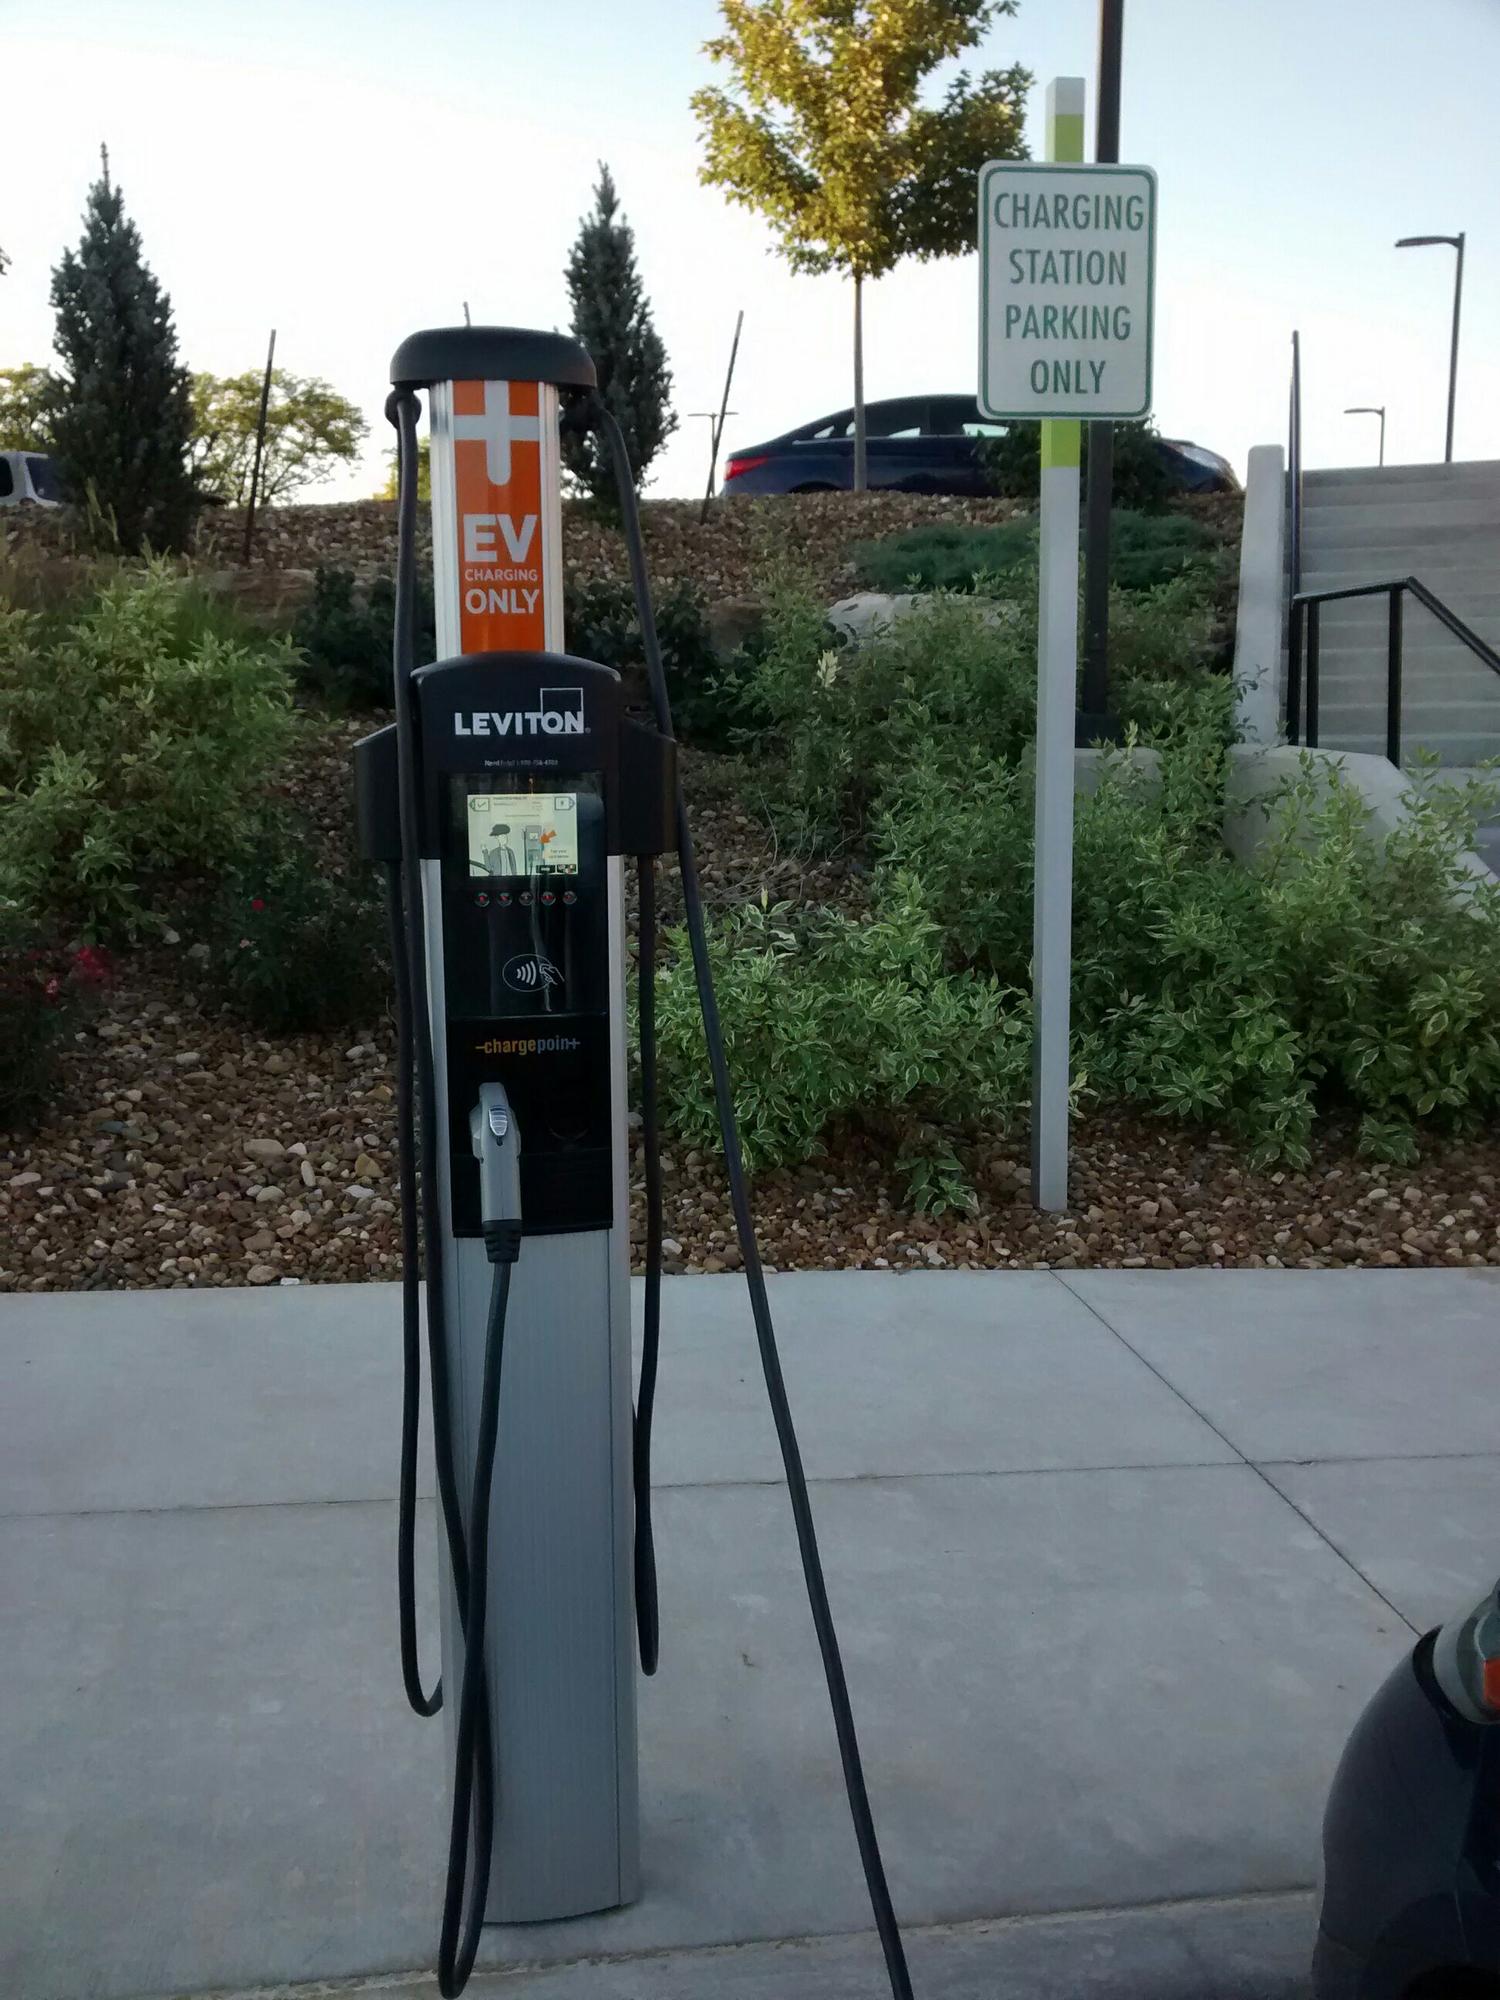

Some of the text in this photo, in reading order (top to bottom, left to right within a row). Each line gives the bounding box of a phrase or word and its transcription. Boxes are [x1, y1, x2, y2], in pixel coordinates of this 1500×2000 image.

[993, 192, 1145, 232] CHARGING
[1008, 248, 1127, 286] STATION
[1004, 303, 1132, 342] PARKING
[1030, 359, 1107, 395] ONLY
[462, 512, 539, 564] EV
[464, 568, 539, 582] CHARGING
[465, 587, 540, 615] ONLY
[454, 710, 585, 736] LEVITON
